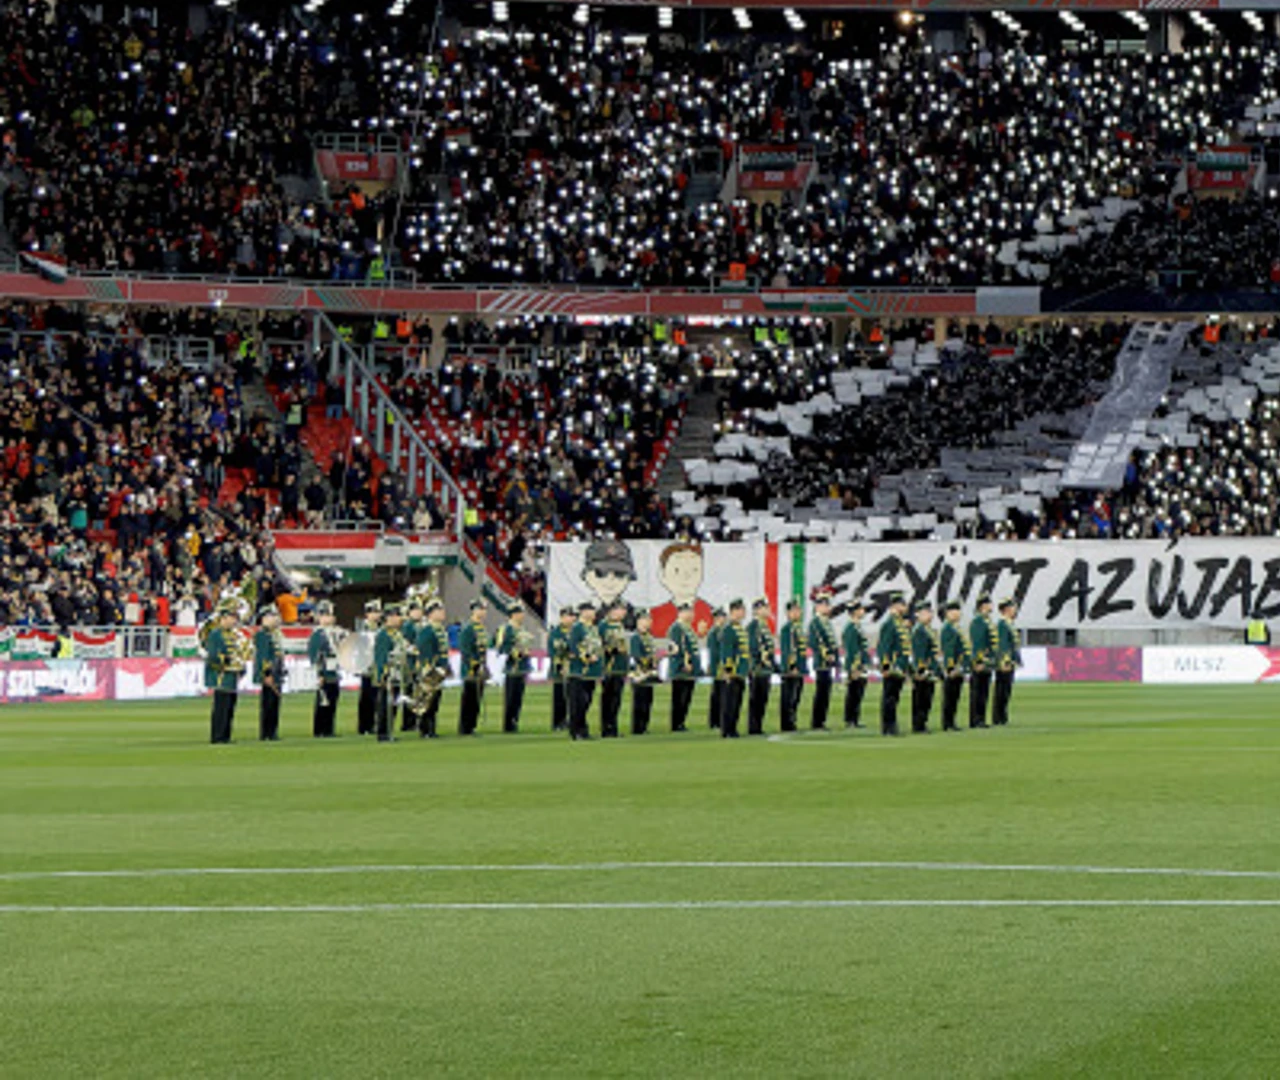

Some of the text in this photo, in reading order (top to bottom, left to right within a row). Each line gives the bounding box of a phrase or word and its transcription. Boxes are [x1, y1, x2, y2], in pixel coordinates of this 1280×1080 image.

[815, 544, 1049, 623] EGYÜTT
[1036, 556, 1136, 622] AZ
[1173, 656, 1225, 671] MLSZ
